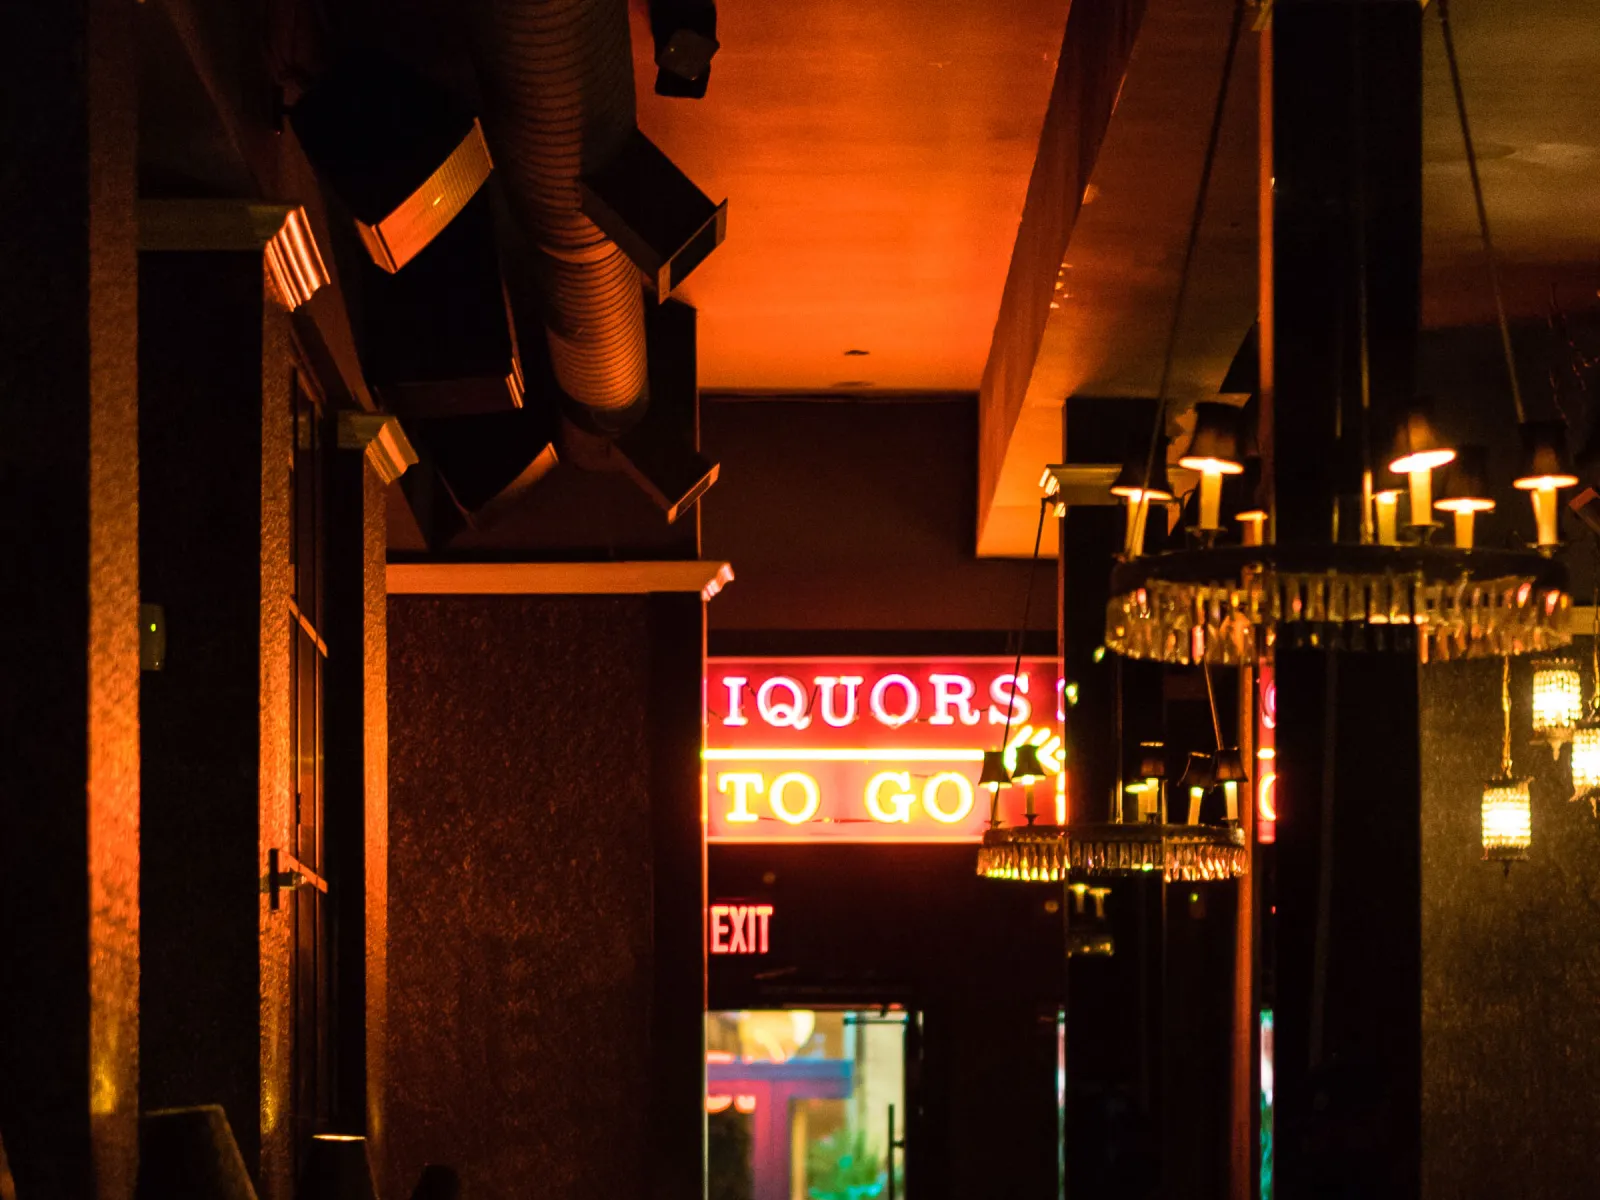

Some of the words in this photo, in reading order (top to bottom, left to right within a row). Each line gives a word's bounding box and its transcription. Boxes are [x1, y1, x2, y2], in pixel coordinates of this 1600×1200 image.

[717, 771, 821, 825] TO
[864, 770, 976, 825] GO
[709, 904, 773, 954] EXIT
